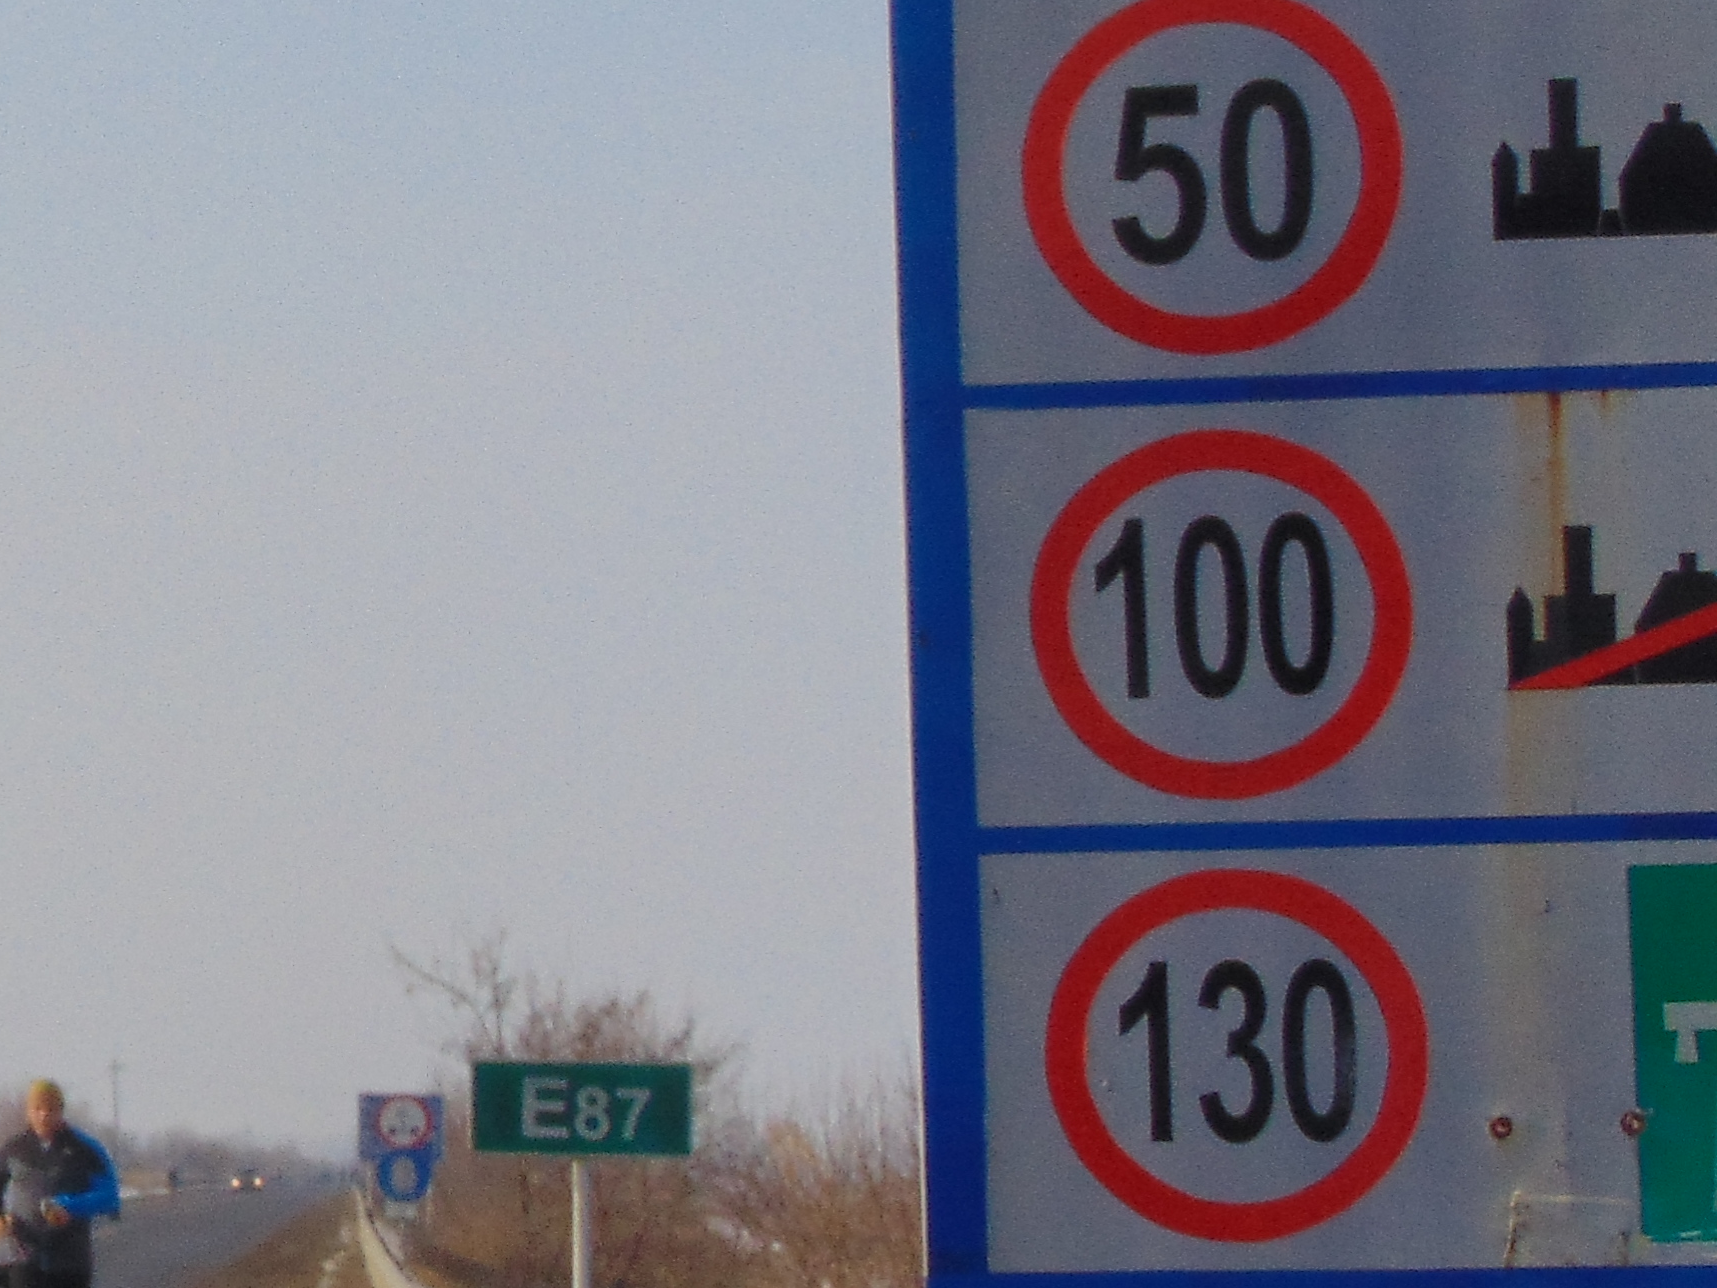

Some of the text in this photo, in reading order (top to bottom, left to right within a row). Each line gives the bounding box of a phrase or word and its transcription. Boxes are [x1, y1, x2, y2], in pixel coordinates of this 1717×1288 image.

[1112, 78, 1315, 266] 50
[1094, 511, 1335, 700] 100
[521, 1076, 653, 1142] E87
[1118, 958, 1358, 1145] 130
